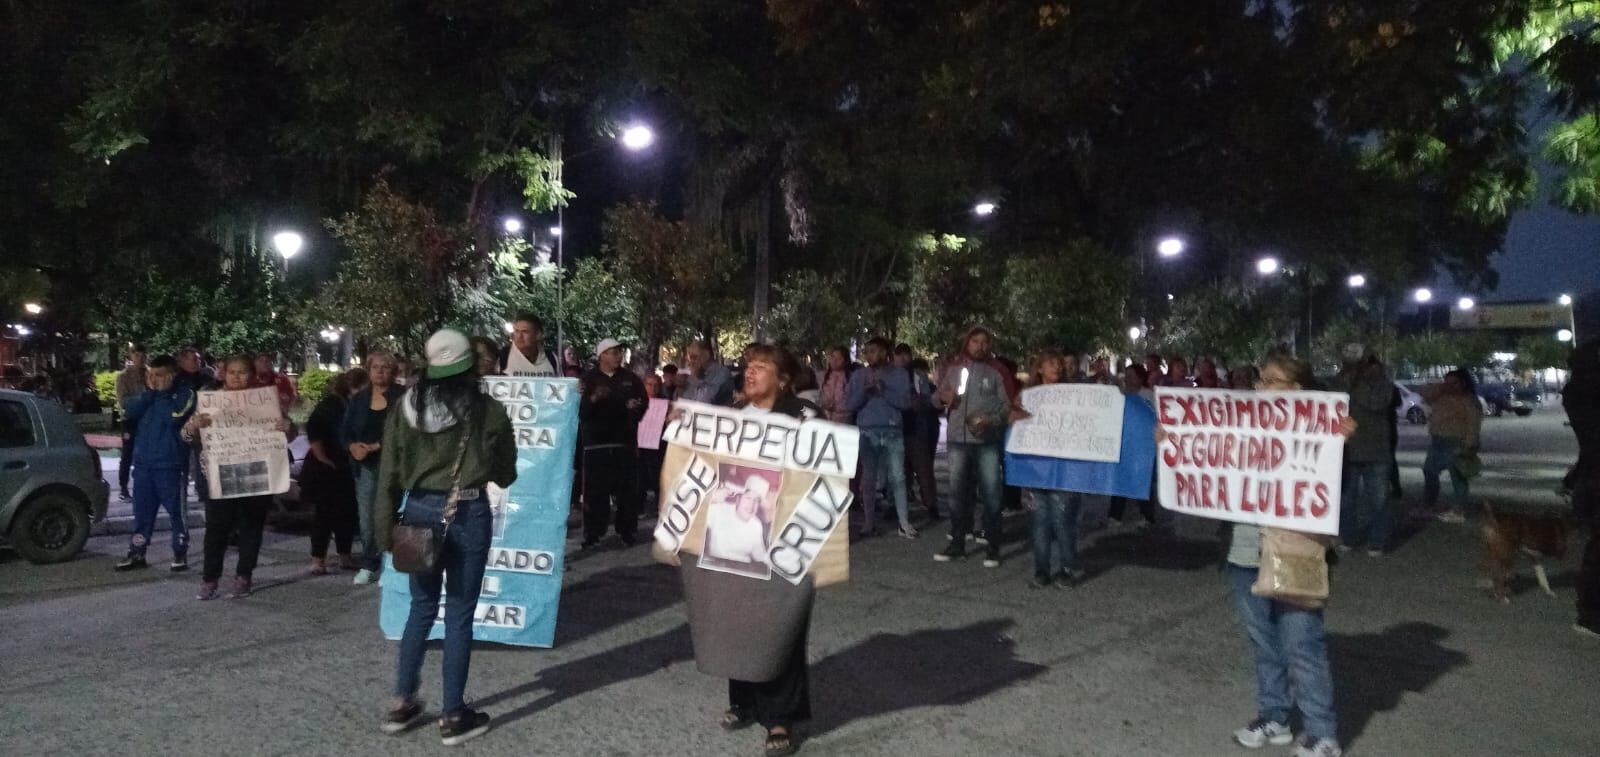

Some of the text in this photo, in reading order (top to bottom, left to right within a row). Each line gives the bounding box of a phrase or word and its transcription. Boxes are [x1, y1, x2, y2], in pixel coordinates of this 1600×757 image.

[546, 383, 564, 402] X
[518, 428, 554, 447] RA
[674, 407, 843, 472] PERPETUA
[1293, 399, 1347, 436] MAS
[1163, 431, 1286, 472] SEGURIDAD
[663, 454, 718, 551] JOSE
[1175, 471, 1330, 519] PARA LULES
[769, 475, 851, 578] CRUZ
